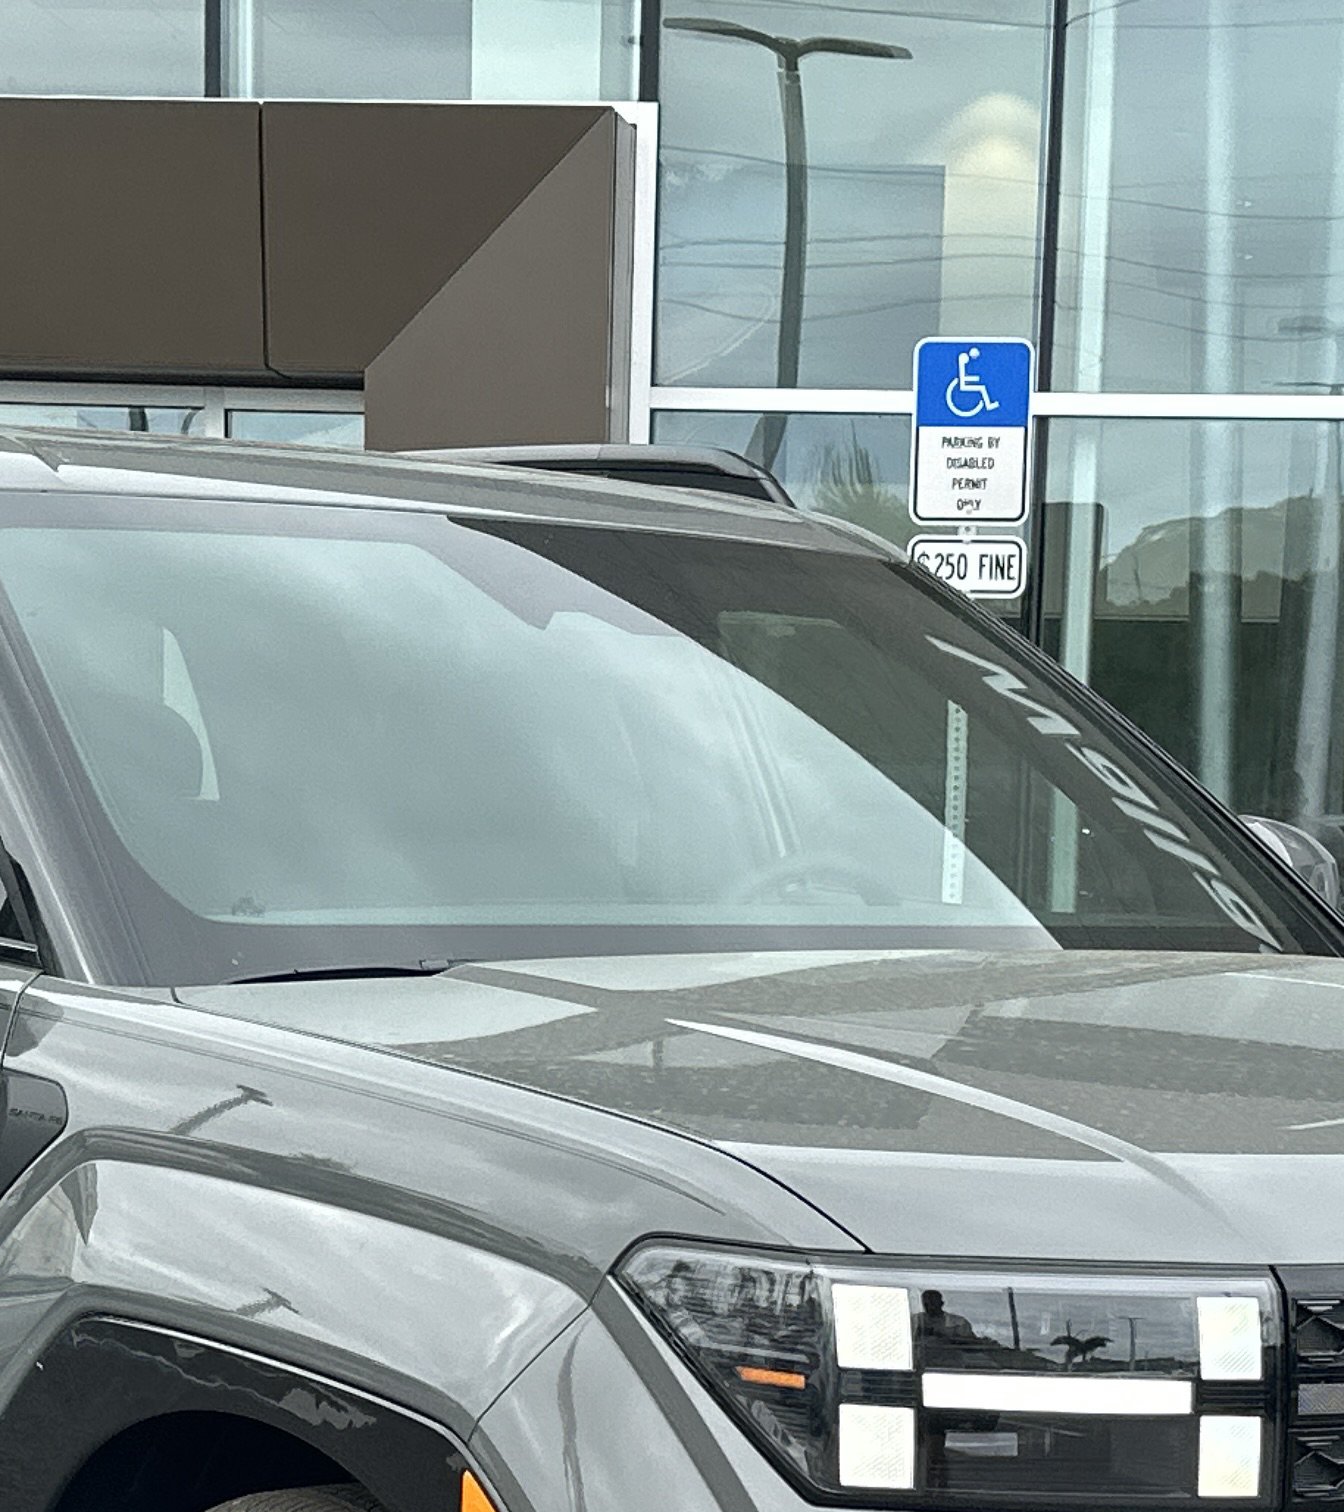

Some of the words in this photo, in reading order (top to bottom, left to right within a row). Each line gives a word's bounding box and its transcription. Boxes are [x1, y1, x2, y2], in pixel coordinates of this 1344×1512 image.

[940, 436, 983, 449] PARKING
[987, 436, 1001, 449] BY
[946, 456, 995, 470] DISABLED
[951, 477, 988, 490] PERMIT
[978, 553, 1017, 581] FINE
